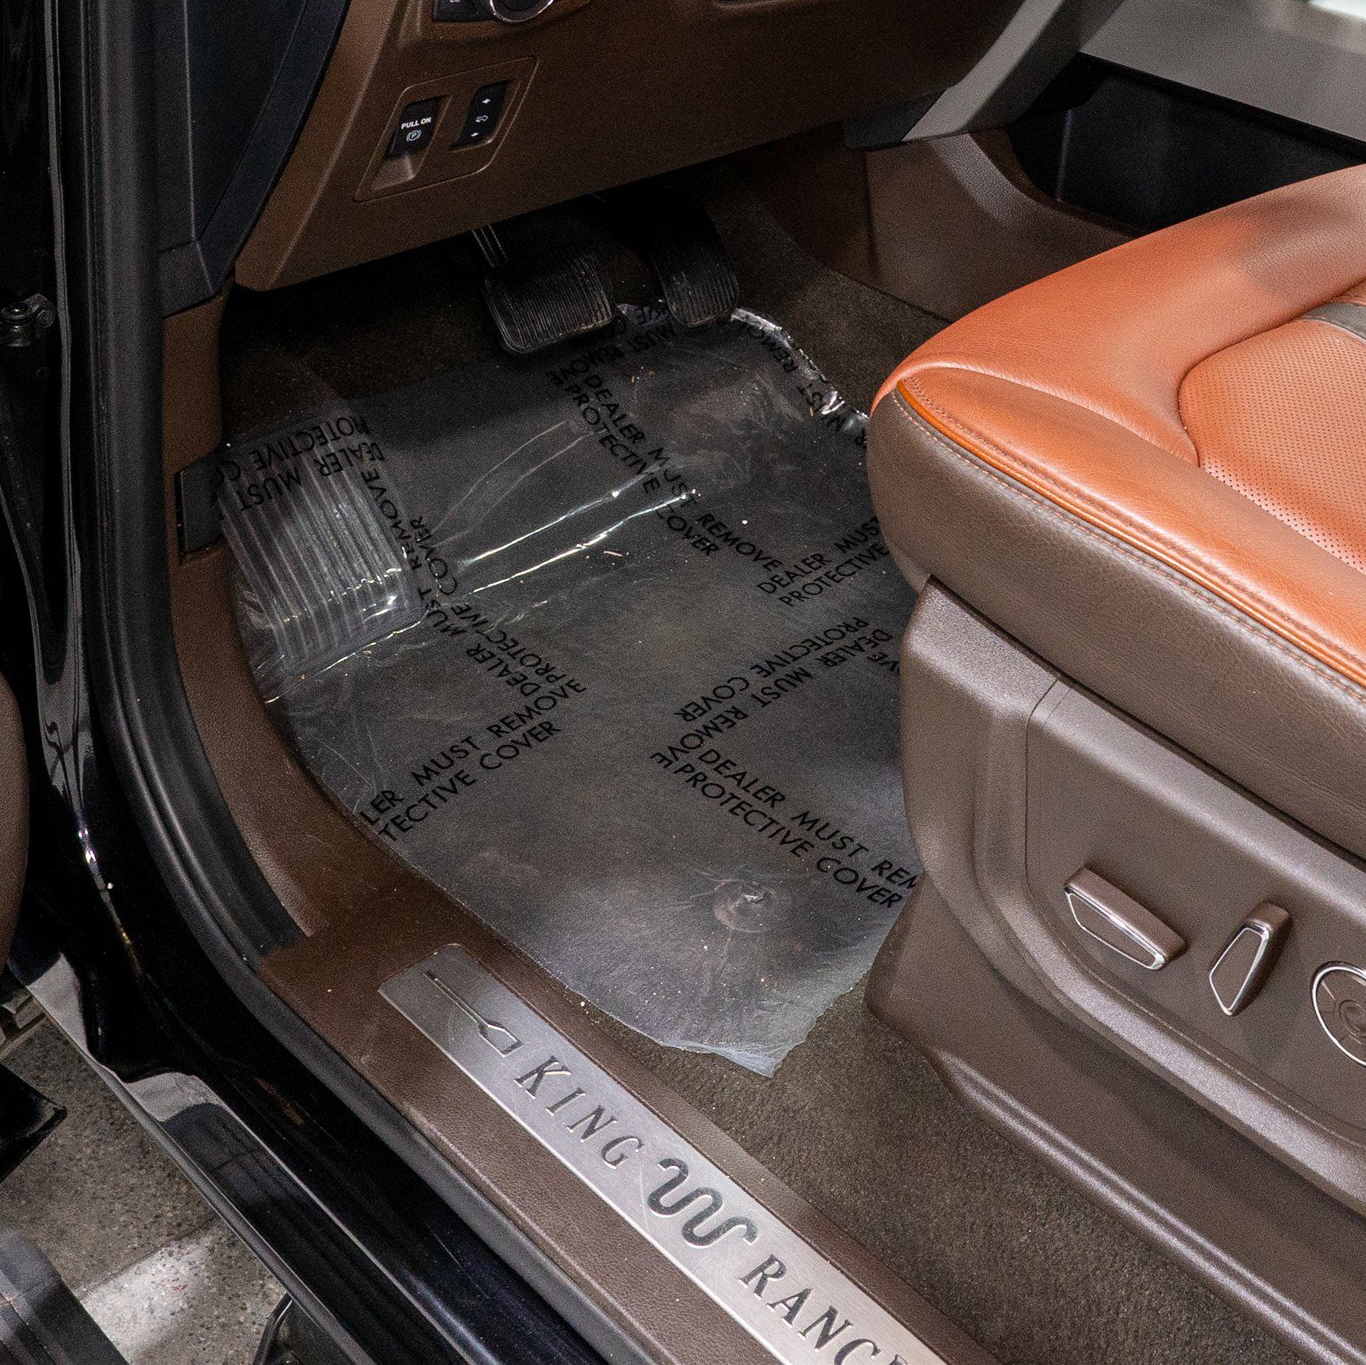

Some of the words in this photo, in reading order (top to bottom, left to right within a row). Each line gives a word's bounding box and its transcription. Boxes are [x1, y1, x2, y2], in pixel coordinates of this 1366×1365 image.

[401, 120, 420, 130] PULL
[420, 116, 432, 125] ON
[563, 384, 661, 495] PROTECTIVE
[585, 374, 646, 445] DEALER
[696, 513, 783, 573] REMOVE
[361, 466, 422, 571] REMOVE
[758, 552, 833, 595] DEALER
[778, 542, 891, 608] PROTECTIVE
[466, 643, 542, 697] DEALER
[750, 616, 871, 679] PROTECTIVE
[815, 628, 893, 668] DEALER
[673, 676, 750, 723] COVER
[751, 666, 814, 708] MUST
[410, 736, 481, 787] MUST
[486, 678, 587, 739] REMOVE
[480, 720, 562, 771] COVER
[650, 706, 749, 769] REMOVE
[698, 748, 785, 809] DEALER
[791, 810, 870, 858] MUST
[673, 762, 815, 858] PROTECTIVE
[816, 856, 903, 909] COVER
[514, 1055, 646, 1170] KING
[737, 1254, 908, 1365] RANC
